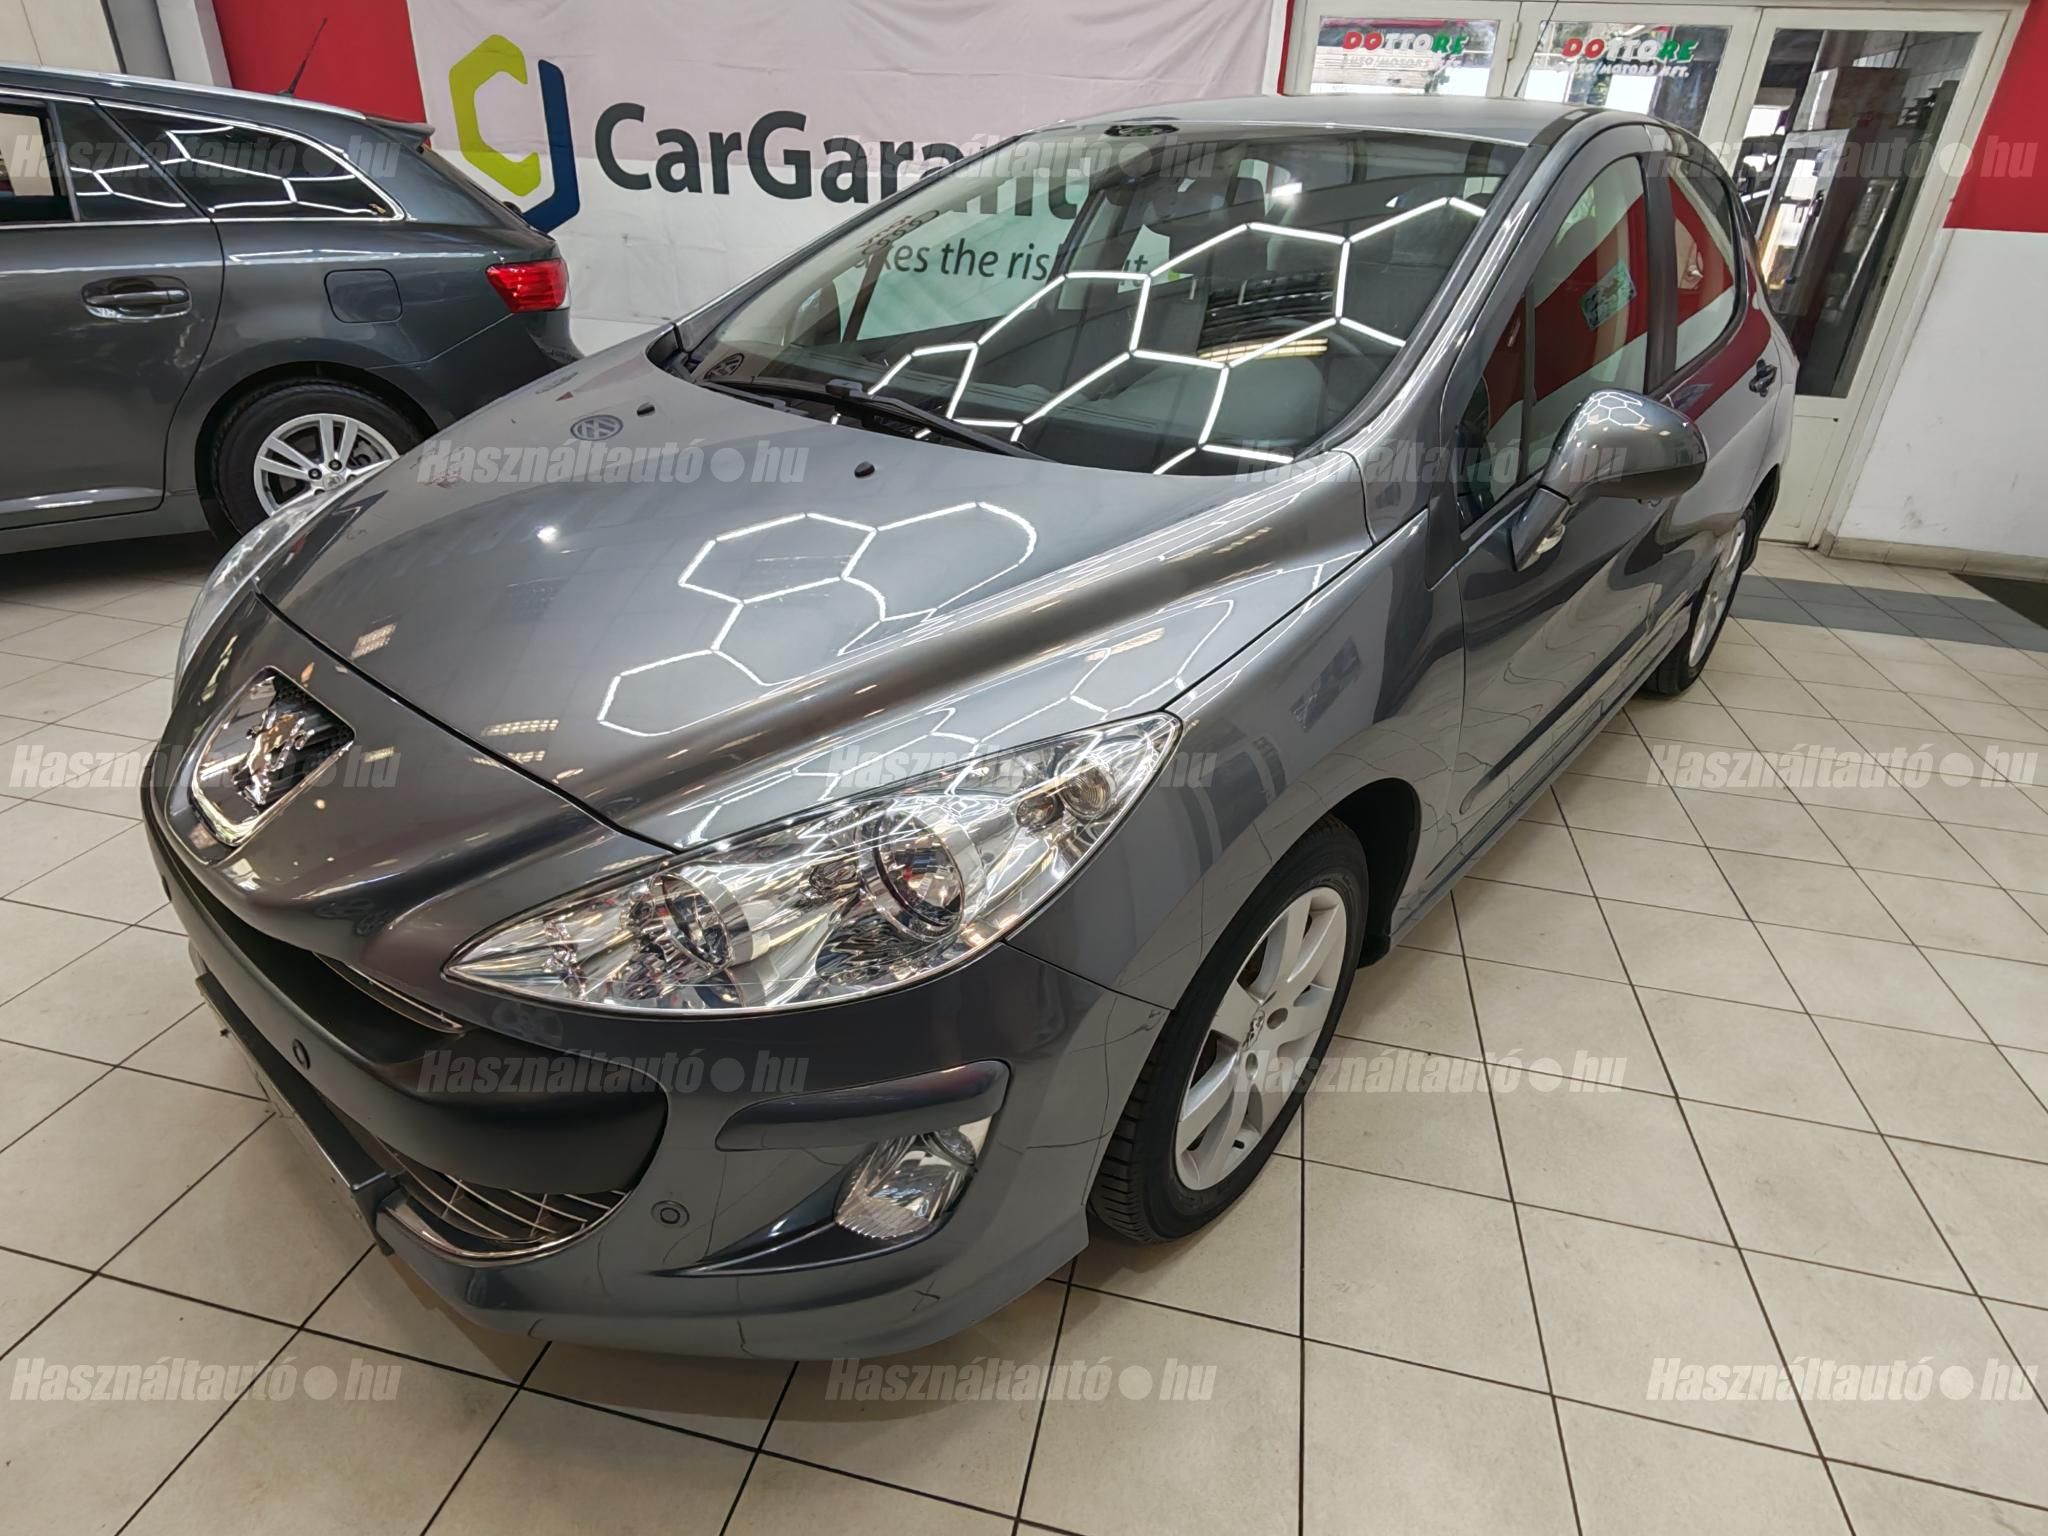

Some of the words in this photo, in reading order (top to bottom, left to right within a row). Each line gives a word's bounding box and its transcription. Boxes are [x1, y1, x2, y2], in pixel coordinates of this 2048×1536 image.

[1342, 31, 1470, 56] DOTTORE
[1561, 37, 1698, 63] DOTTORE
[940, 237, 999, 277] the
[1006, 243, 1051, 281] ris
